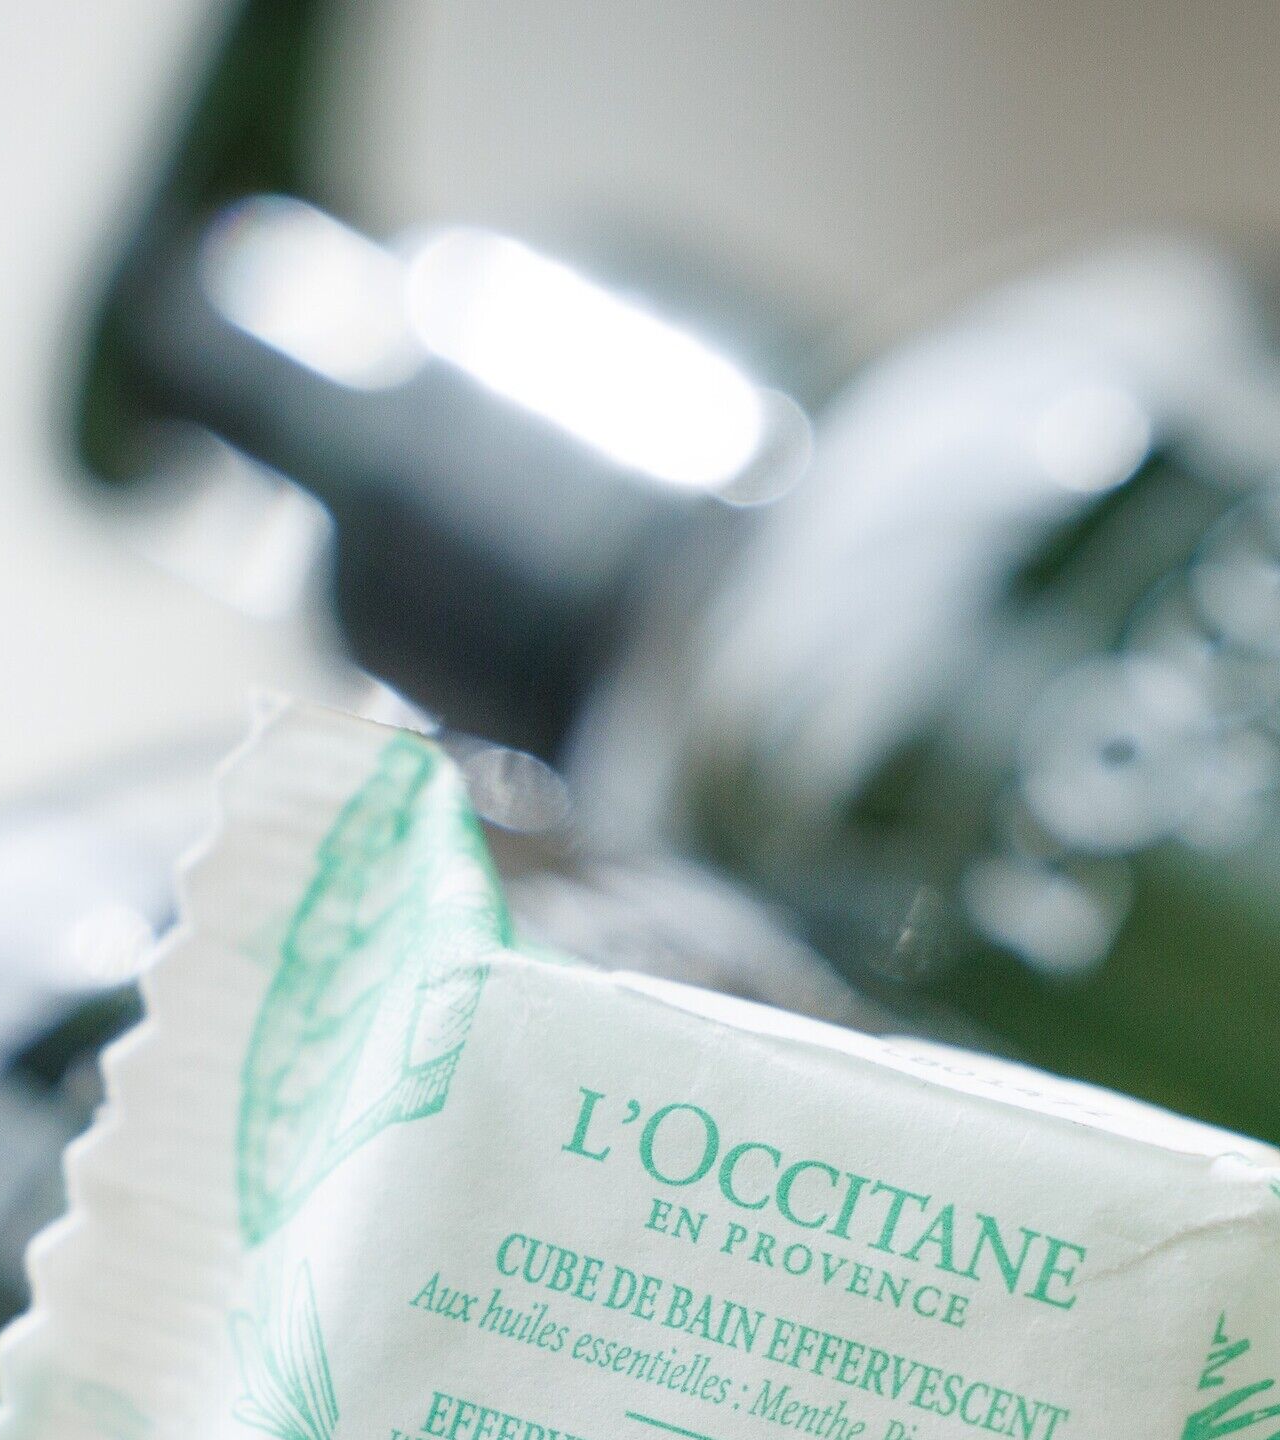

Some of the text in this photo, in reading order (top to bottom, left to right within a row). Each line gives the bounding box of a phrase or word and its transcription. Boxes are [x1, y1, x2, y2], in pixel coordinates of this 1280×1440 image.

[561, 1086, 1087, 1310] L'OCCITANE
[644, 1198, 971, 1328] EN PROVENCE
[408, 1271, 479, 1323] Aux
[478, 1288, 570, 1352] huiles
[571, 1333, 733, 1405] essentielles
[495, 1232, 605, 1302] CUBE
[602, 1265, 663, 1321] DE
[661, 1284, 766, 1353] BAIN
